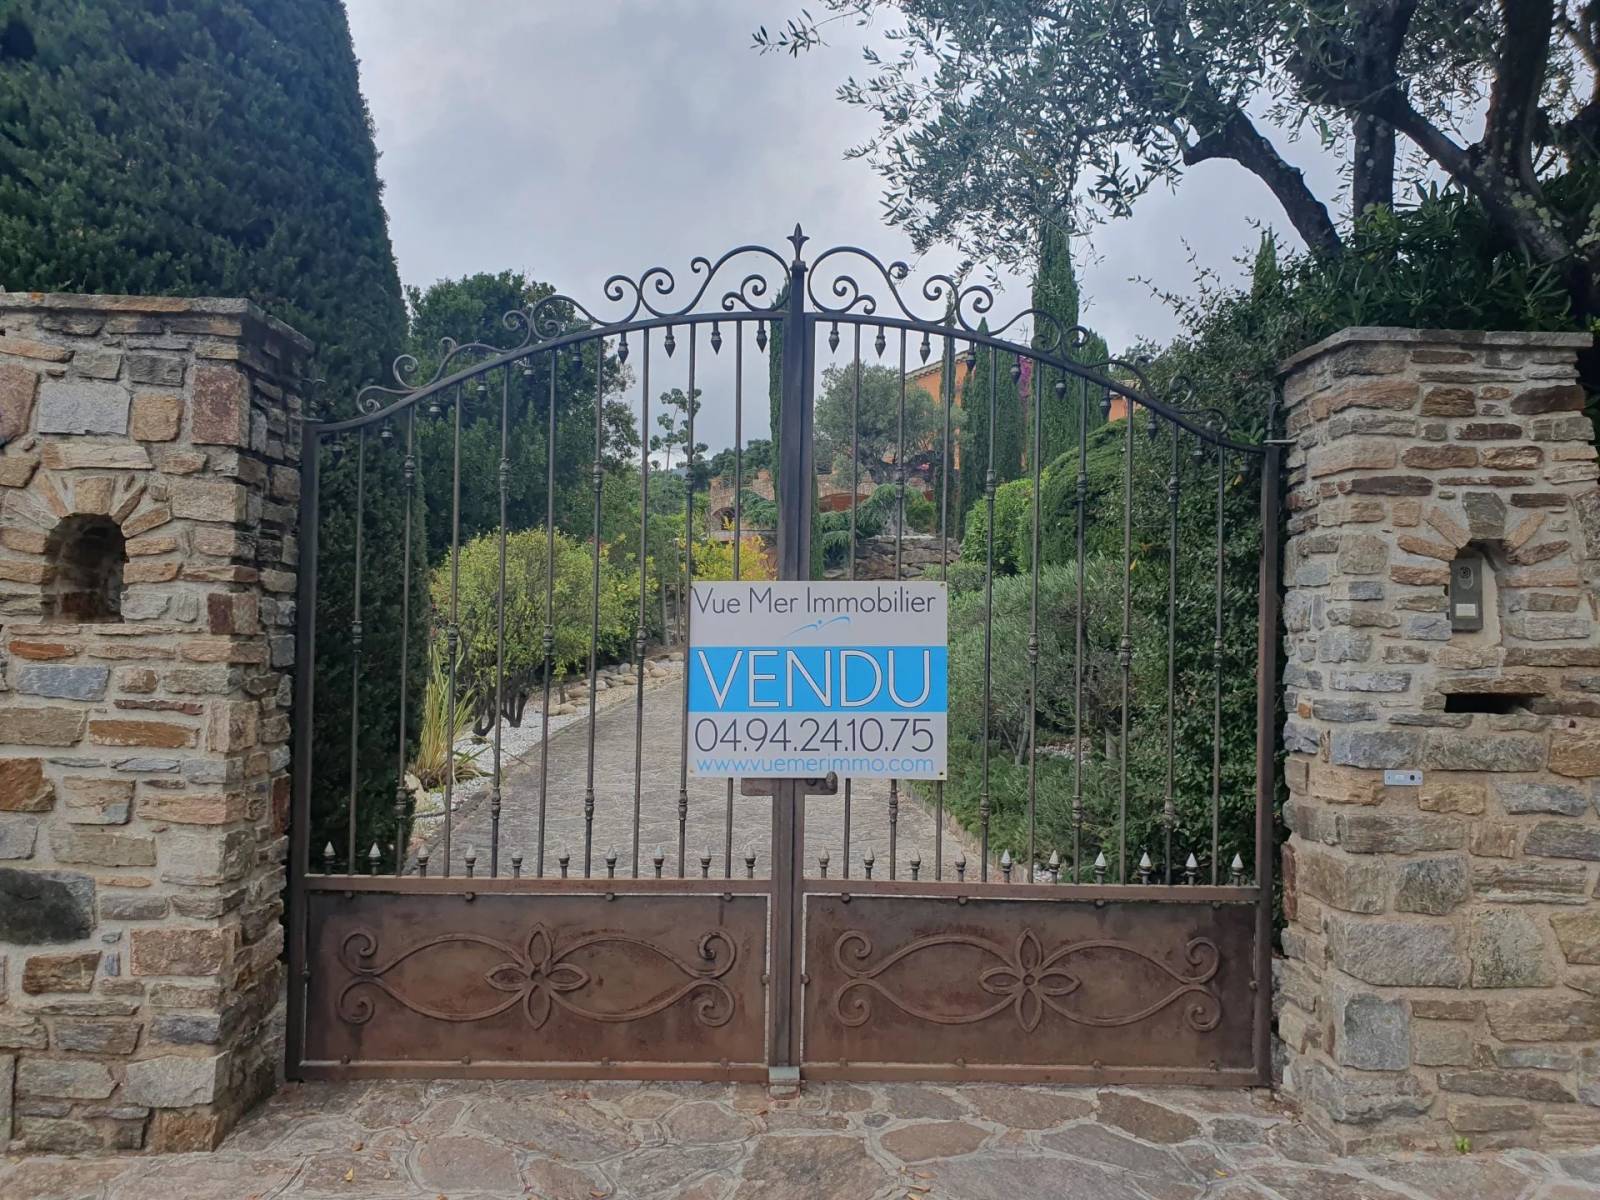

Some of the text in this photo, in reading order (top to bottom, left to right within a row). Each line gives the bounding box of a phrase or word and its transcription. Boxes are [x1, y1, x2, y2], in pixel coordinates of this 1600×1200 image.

[691, 586, 936, 614] Vue Mer Immobilier
[697, 649, 931, 710] VENDU
[695, 717, 934, 752] 04.94.24.10.75
[696, 754, 934, 773] www.vuemerimmo.com
